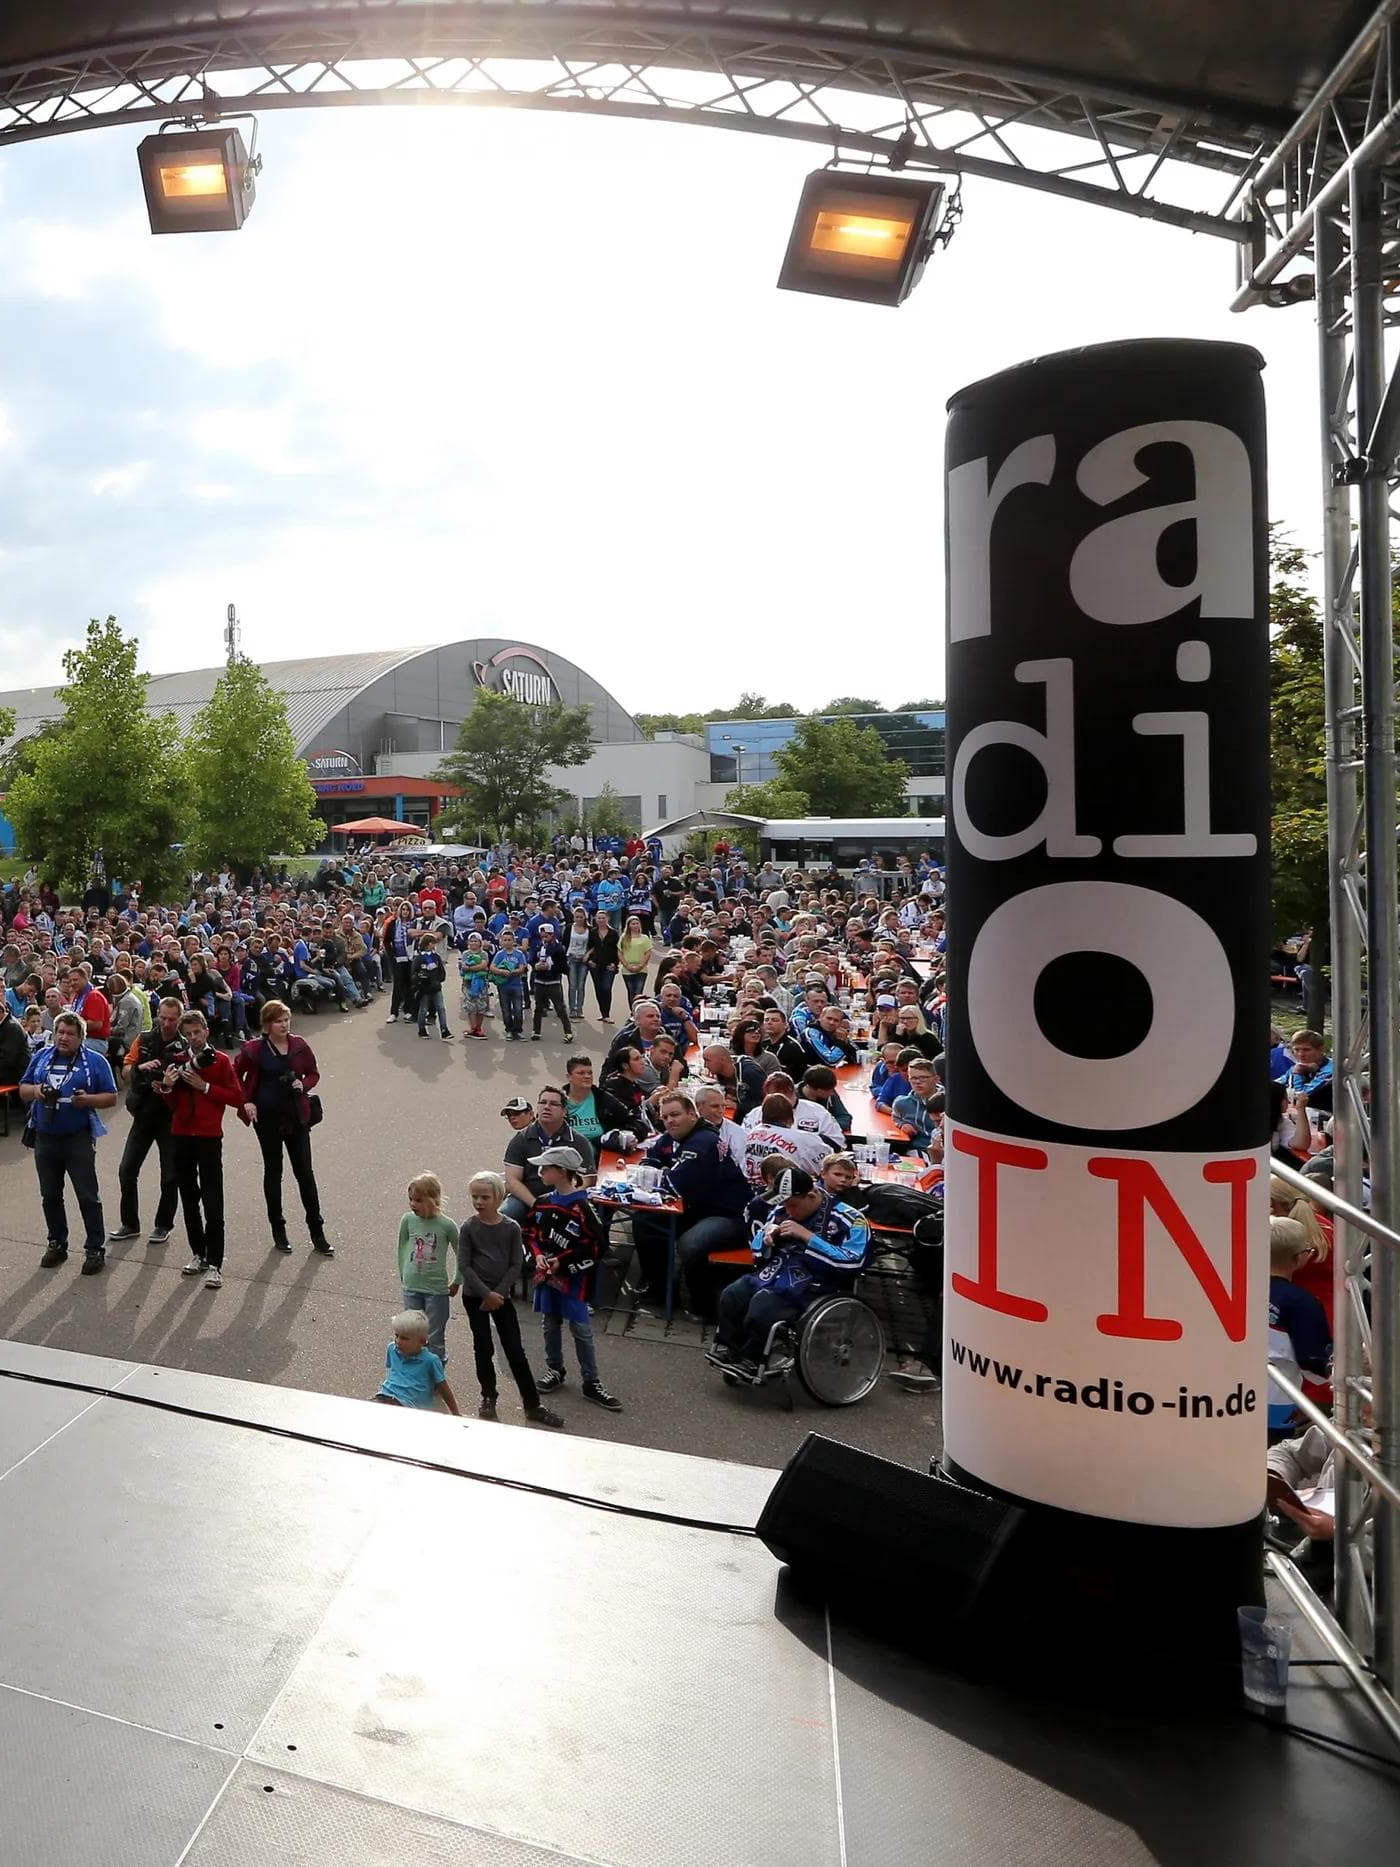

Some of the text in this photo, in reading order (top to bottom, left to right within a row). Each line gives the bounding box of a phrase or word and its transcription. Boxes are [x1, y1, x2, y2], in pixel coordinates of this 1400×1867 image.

[947, 419, 1255, 644] ra
[503, 668, 551, 706] SATURN
[952, 639, 1258, 862] di
[315, 756, 348, 769] SATURN
[951, 1129, 1258, 1343] IN
[950, 1337, 1257, 1419] www.radio-in.de
